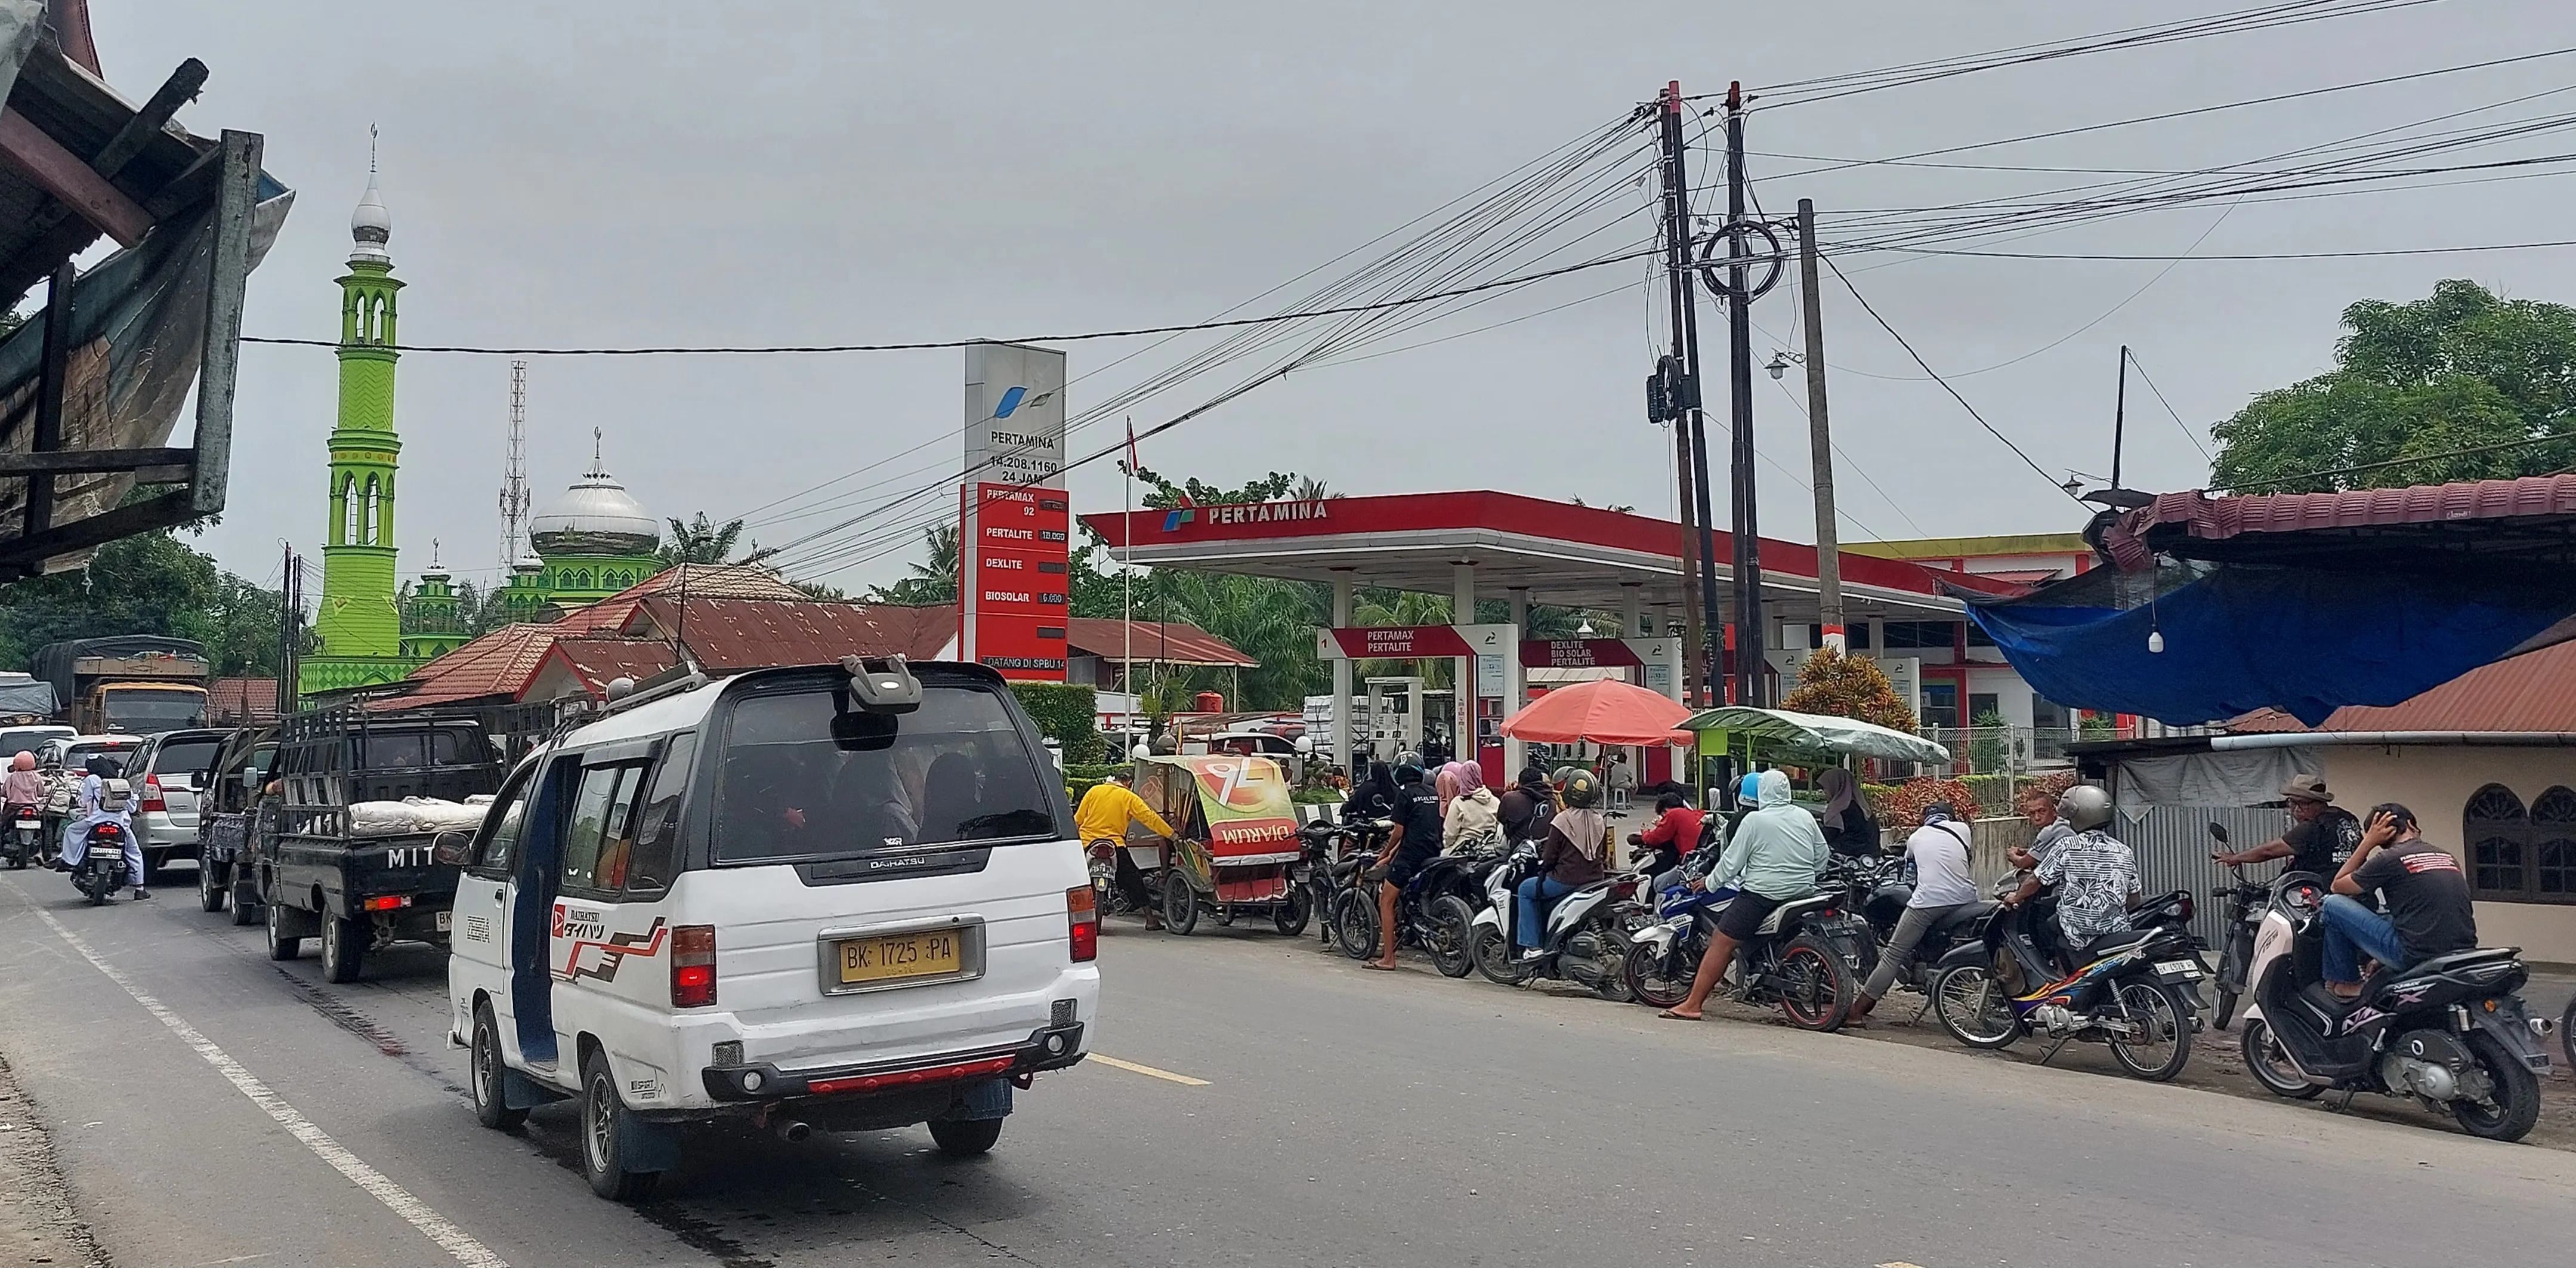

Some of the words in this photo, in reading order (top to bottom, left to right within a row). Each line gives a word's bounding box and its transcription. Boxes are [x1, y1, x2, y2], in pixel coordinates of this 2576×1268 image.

[991, 431, 1055, 449] PERTAMINA
[990, 456, 1058, 473] 14.208.1160
[1002, 471, 1016, 482] 24
[1019, 473, 1043, 486] JAM
[987, 489, 1034, 503] PERTAMAX
[1024, 507, 1035, 516] 92
[1209, 501, 1327, 525] PERTAMINA
[986, 527, 1033, 540] PERTALITE
[986, 558, 1023, 570] DEXLITE
[985, 591, 1030, 603] BIOSOLAR
[1367, 630, 1414, 641] PERTAMAX
[1321, 638, 1328, 649] 1
[1367, 642, 1411, 652] PERTALITE
[1550, 640, 1584, 649] DEXLITE
[1550, 649, 1564, 658] BIO
[1566, 649, 1592, 657] SOLAR
[1023, 659, 1031, 668] DI
[1033, 659, 1055, 668] SPBU
[1551, 657, 1596, 666] PERTALITE
[1221, 825, 1290, 845] DJARUM
[870, 857, 925, 869] DAIHATSU
[439, 913, 452, 924] BK
[570, 910, 600, 923] DAIHATSU
[564, 923, 605, 939] ダイハツ
[847, 946, 868, 968] BK
[879, 941, 918, 965] 1725
[930, 937, 951, 960] PA
